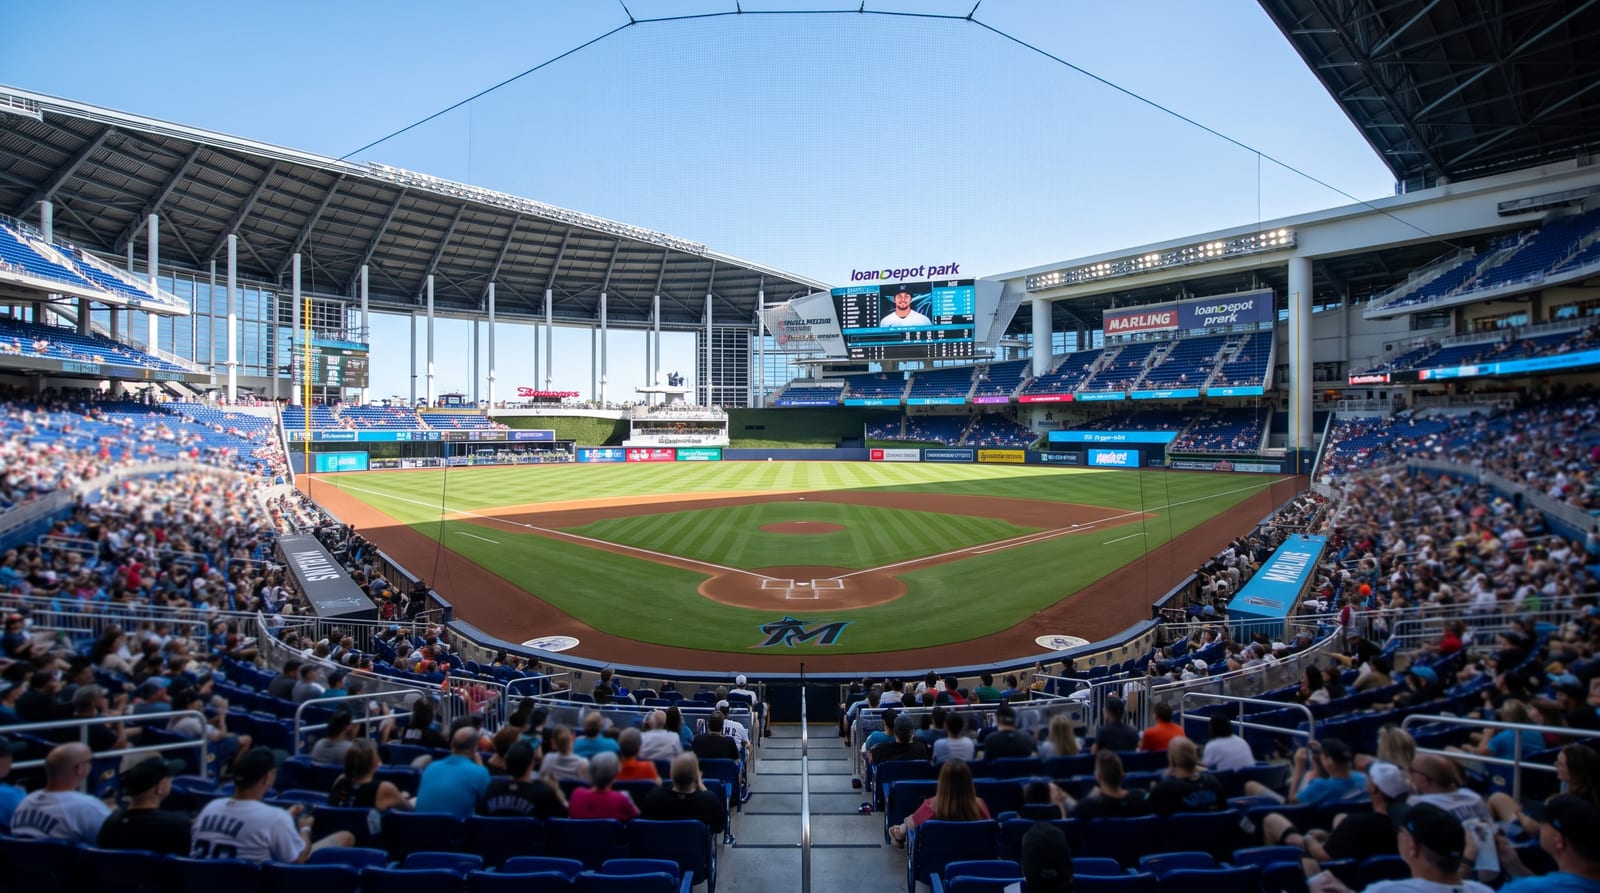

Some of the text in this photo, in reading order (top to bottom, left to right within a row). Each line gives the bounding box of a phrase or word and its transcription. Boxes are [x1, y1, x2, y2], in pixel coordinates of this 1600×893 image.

[851, 262, 960, 282] loanDepot park
[1194, 299, 1254, 317] loanDepot
[1109, 312, 1171, 331] MARLING
